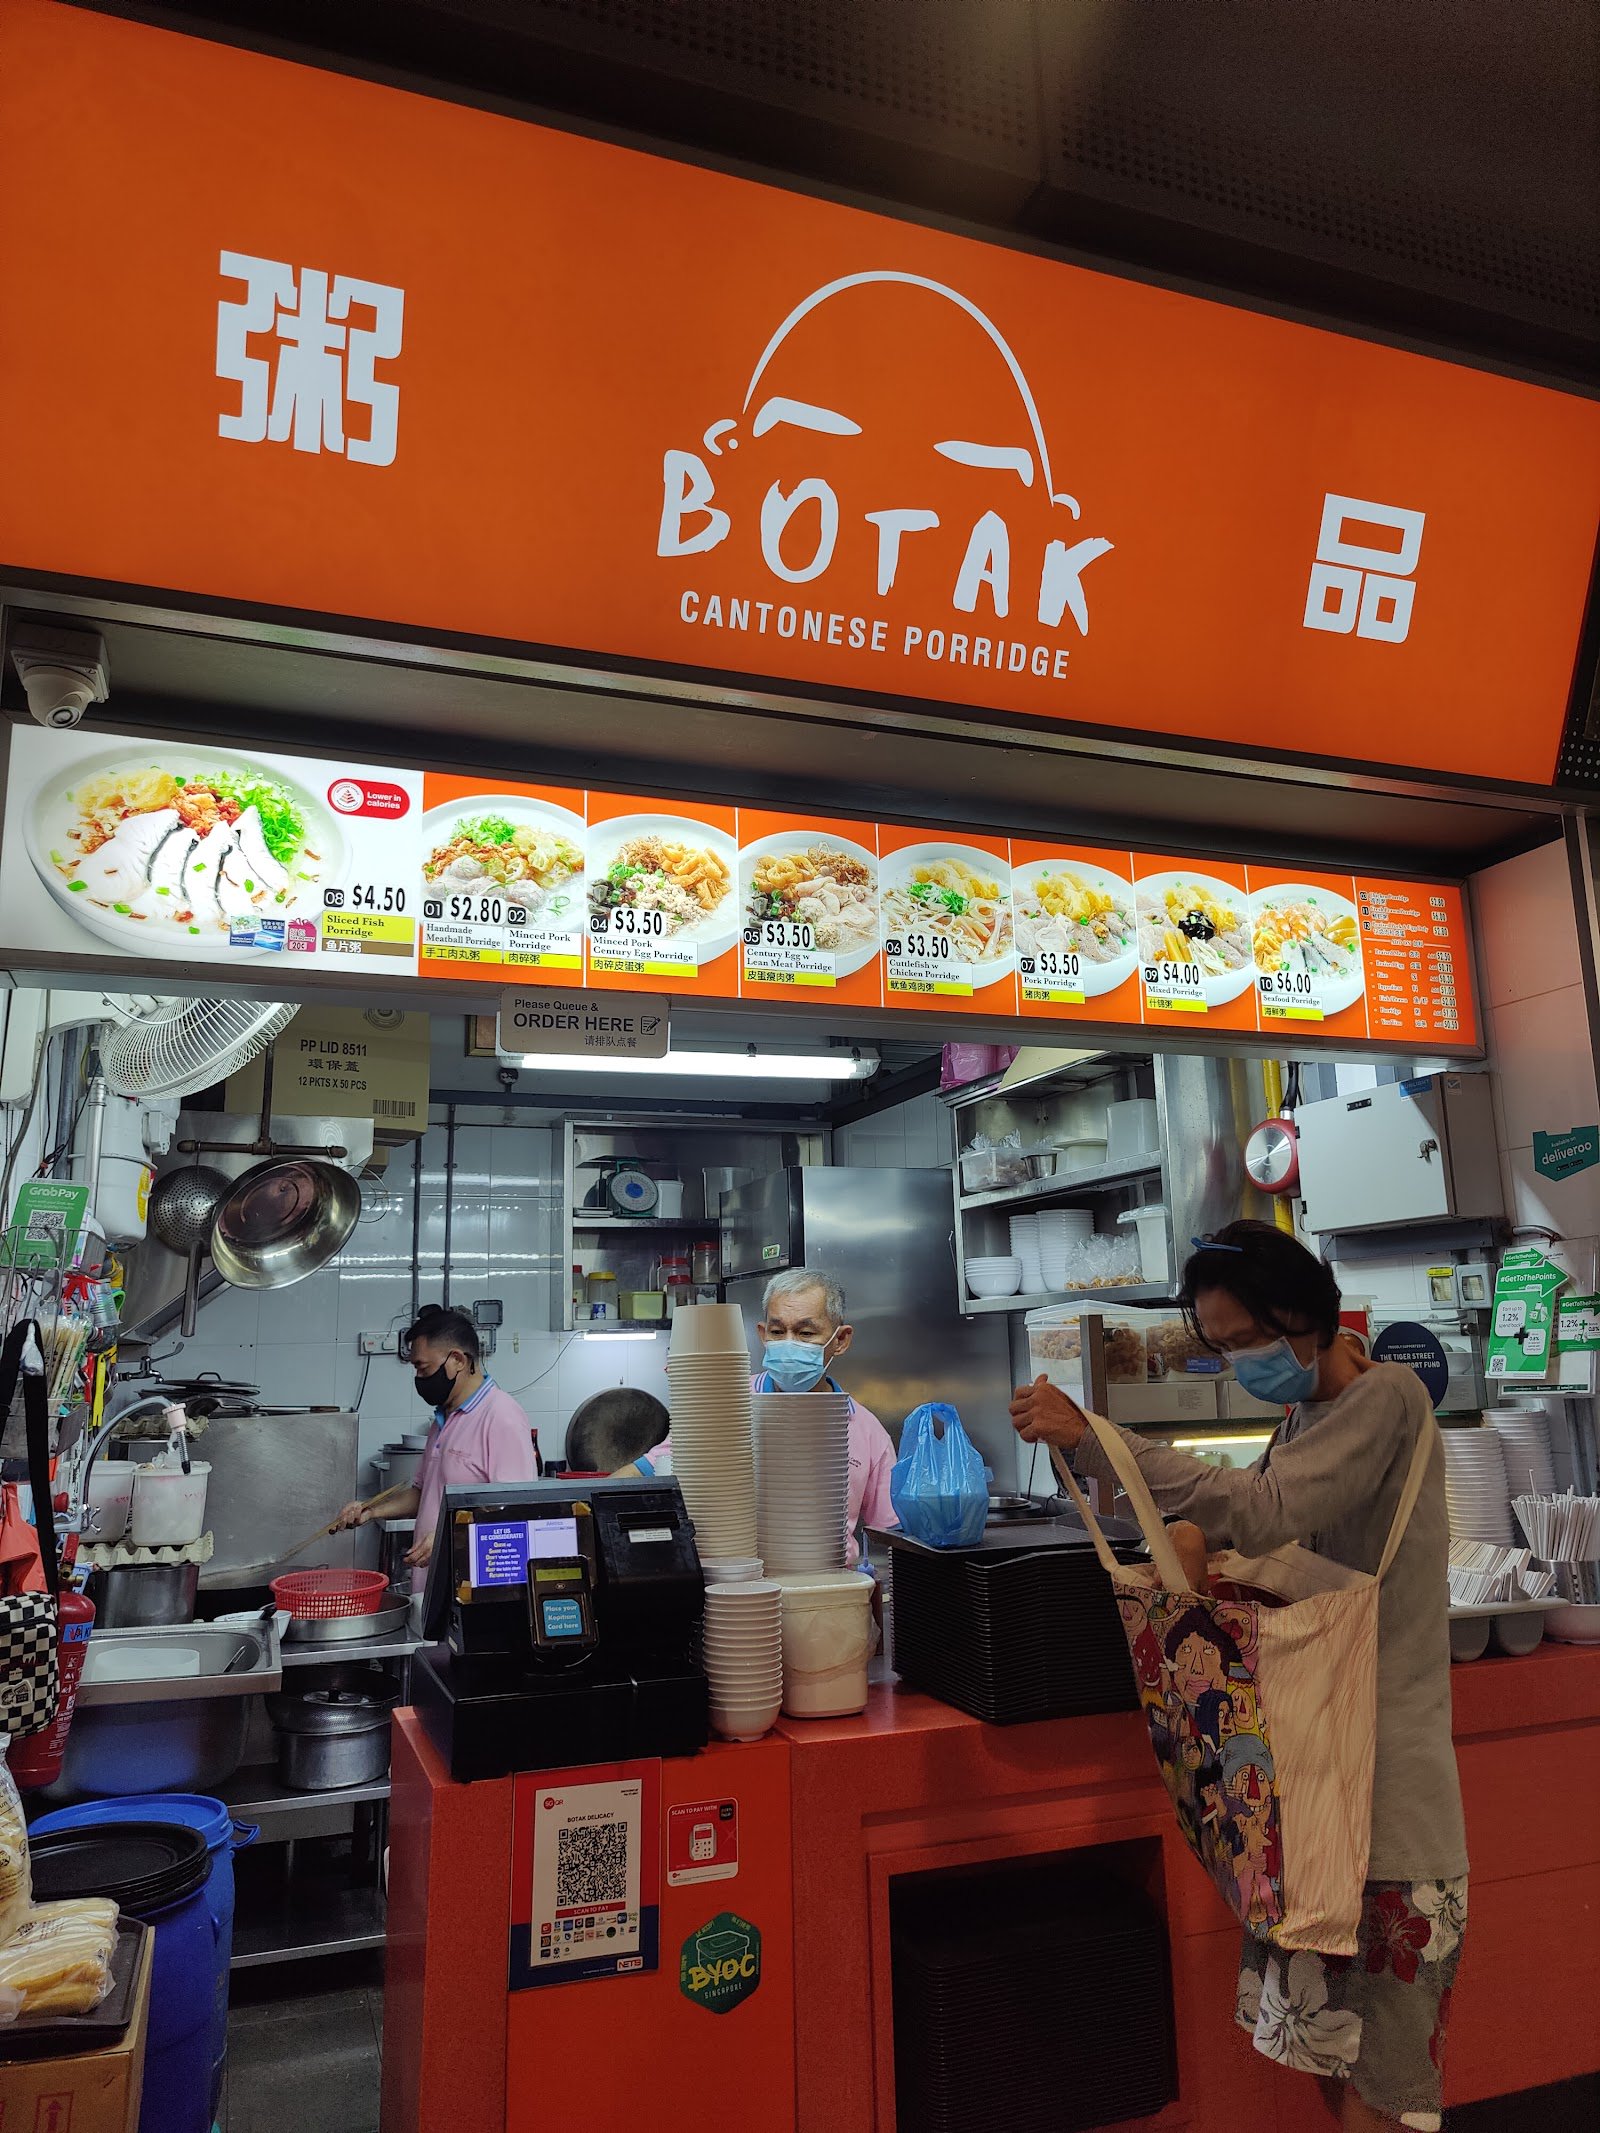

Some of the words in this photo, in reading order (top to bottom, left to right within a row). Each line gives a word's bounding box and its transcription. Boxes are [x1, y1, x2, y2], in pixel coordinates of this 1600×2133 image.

[216, 250, 404, 466] 粥
[657, 450, 1114, 636] BOTAK
[1303, 493, 1425, 643] 品
[679, 590, 888, 652] CANTONESE
[903, 625, 1070, 679] PORRIDGE
[367, 792, 392, 800] Lower
[367, 800, 400, 809] calories
[326, 892, 344, 905] 08
[352, 883, 405, 912] $4.50
[425, 903, 441, 916] 01
[450, 897, 501, 923] $2.80
[508, 910, 525, 922] 02
[327, 915, 359, 925] Sliced
[363, 918, 385, 927] Fish
[591, 919, 607, 930] 04
[616, 910, 662, 935] $3.50
[327, 925, 373, 938] Porridge
[427, 924, 473, 934] Handmade
[745, 931, 759, 942] 05
[767, 922, 810, 947] $3.50
[426, 934, 464, 944] Meatball
[465, 936, 501, 947] Porridge
[509, 930, 546, 940] Minced
[549, 933, 571, 942] Pork
[593, 936, 628, 946] Minced
[631, 938, 652, 948] Pork
[326, 940, 361, 953] 鱼片粥
[509, 940, 551, 951] Porridge
[887, 942, 901, 953] 06
[908, 934, 948, 958] $3.50
[426, 948, 480, 961] 手工肉丸粥
[509, 954, 540, 965] 肉碎粥
[593, 946, 632, 958] Century
[634, 949, 651, 960] Egg
[654, 950, 693, 962] Porridge
[747, 948, 782, 959] Century
[785, 950, 800, 961] Egg
[594, 960, 644, 972] 肉碎皮蛋粥
[747, 958, 769, 966] Lean
[771, 960, 793, 968] Meat
[795, 961, 832, 972] Porridge
[889, 959, 929, 969] Cuttlefish
[1021, 960, 1034, 971] 07
[1041, 953, 1079, 975] $3.50
[747, 970, 795, 982] 皮蛋瘦肉粥
[889, 968, 922, 977] Chicken
[925, 971, 960, 981] Porridge
[1146, 970, 1157, 980] 09
[1164, 962, 1199, 985] $4.00
[1044, 978, 1076, 988] Porridge
[1261, 979, 1272, 990] 10
[1277, 972, 1311, 993] $6.00
[1025, 990, 1050, 1000] 猪肉粥
[1148, 986, 1171, 994] Mixed
[1172, 987, 1203, 997] Porridge
[514, 999, 550, 1009] Please
[553, 1001, 588, 1011] Queue
[590, 1003, 599, 1011] &
[1263, 995, 1289, 1003] Seafood
[1291, 996, 1320, 1006] Porridge
[514, 1013, 579, 1029] ORDER
[585, 1017, 633, 1032] HERE
[584, 1035, 637, 1048] 请排队点餐
[300, 1040, 316, 1052] PP
[320, 1042, 339, 1053] LID
[342, 1043, 367, 1057] 8511
[308, 1059, 360, 1072] 環保蓋
[299, 1077, 307, 1086] 12
[310, 1077, 331, 1087] PKTS
[332, 1079, 338, 1088] X
[340, 1080, 349, 1089] 50
[351, 1081, 367, 1090] PCS
[1542, 1142, 1591, 1164] deliveroo
[29, 1187, 79, 1200] GrabPay
[1501, 1274, 1556, 1283] #GetToThePoints
[1561, 1320, 1578, 1328] 1.2%
[587, 1812, 614, 1820] DELICACY
[574, 1907, 589, 1915] SCAN
[619, 1959, 641, 1969] NETS
[688, 1954, 755, 1992] BYOC
[704, 1983, 742, 1999] SINGAPORE
